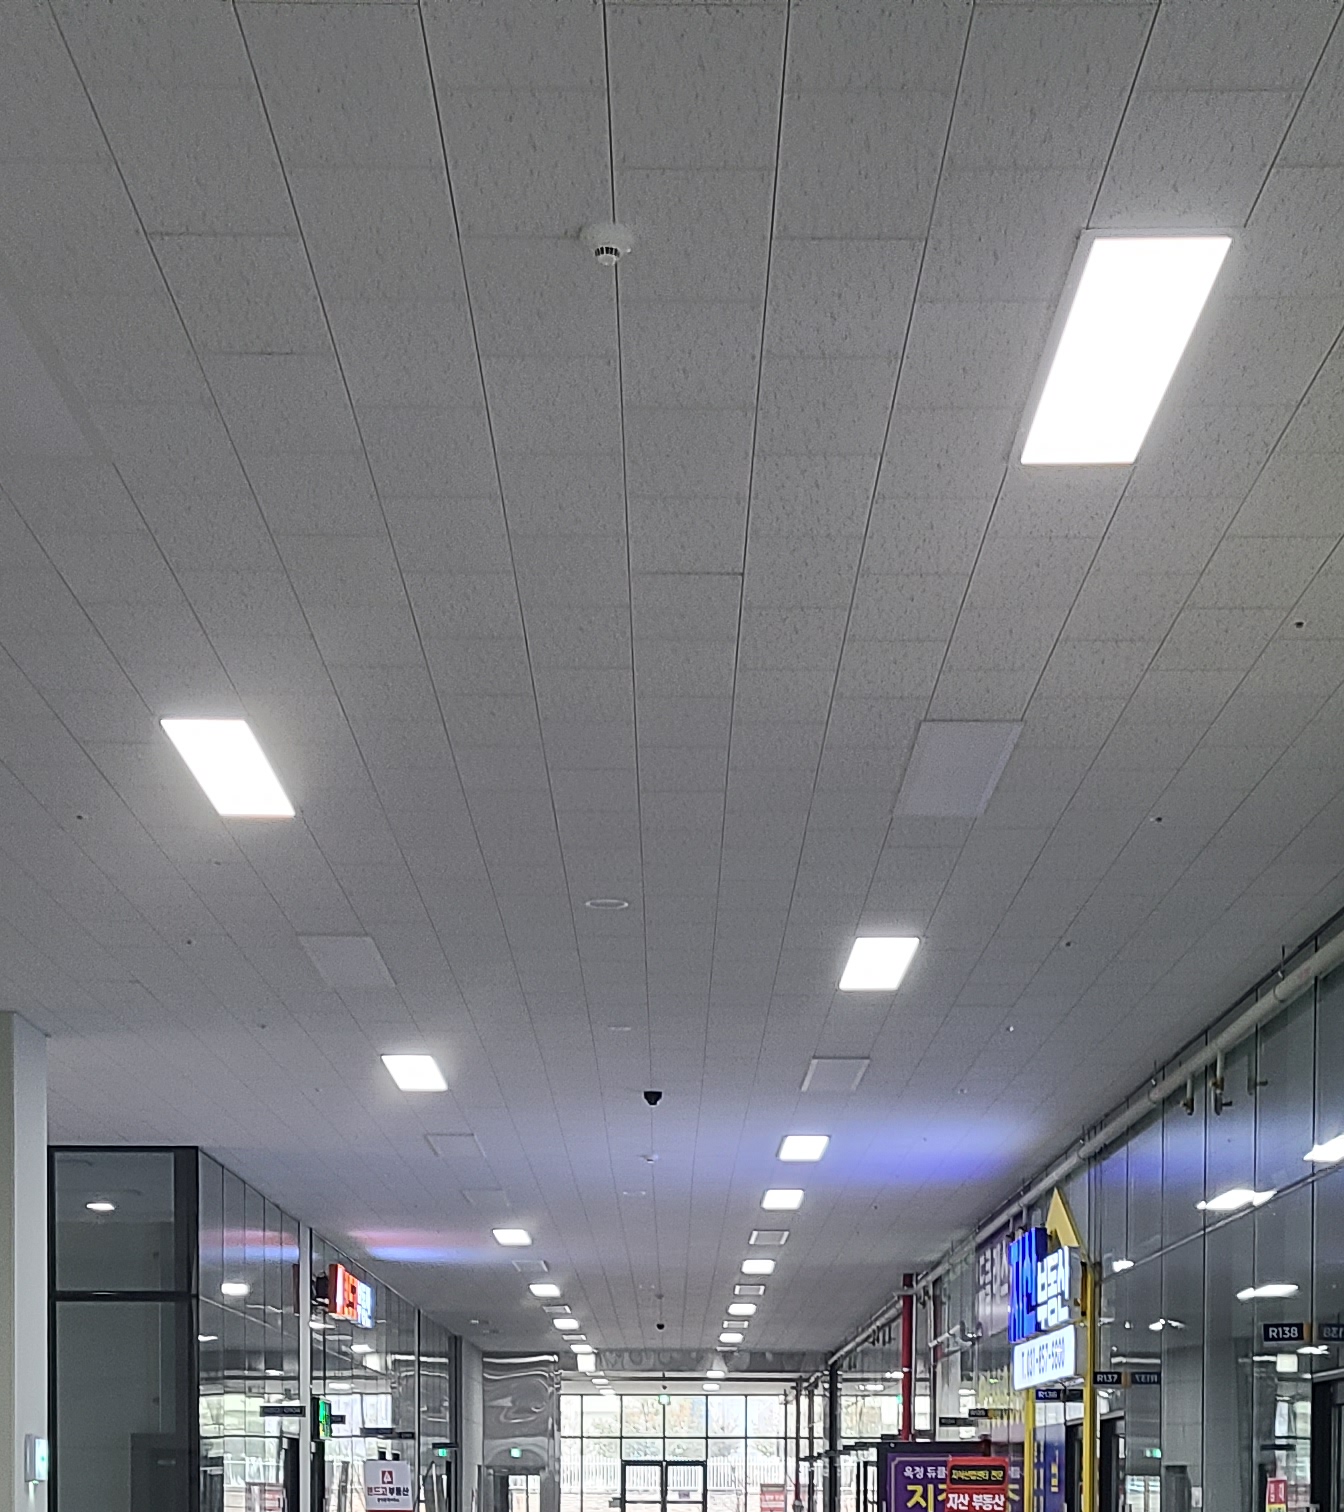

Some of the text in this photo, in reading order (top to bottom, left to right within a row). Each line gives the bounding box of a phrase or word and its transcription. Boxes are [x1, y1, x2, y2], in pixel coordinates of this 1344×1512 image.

[1269, 1327, 1298, 1338] R138
[1097, 1374, 1118, 1383] R137
[972, 1493, 1005, 1511] 부동산
